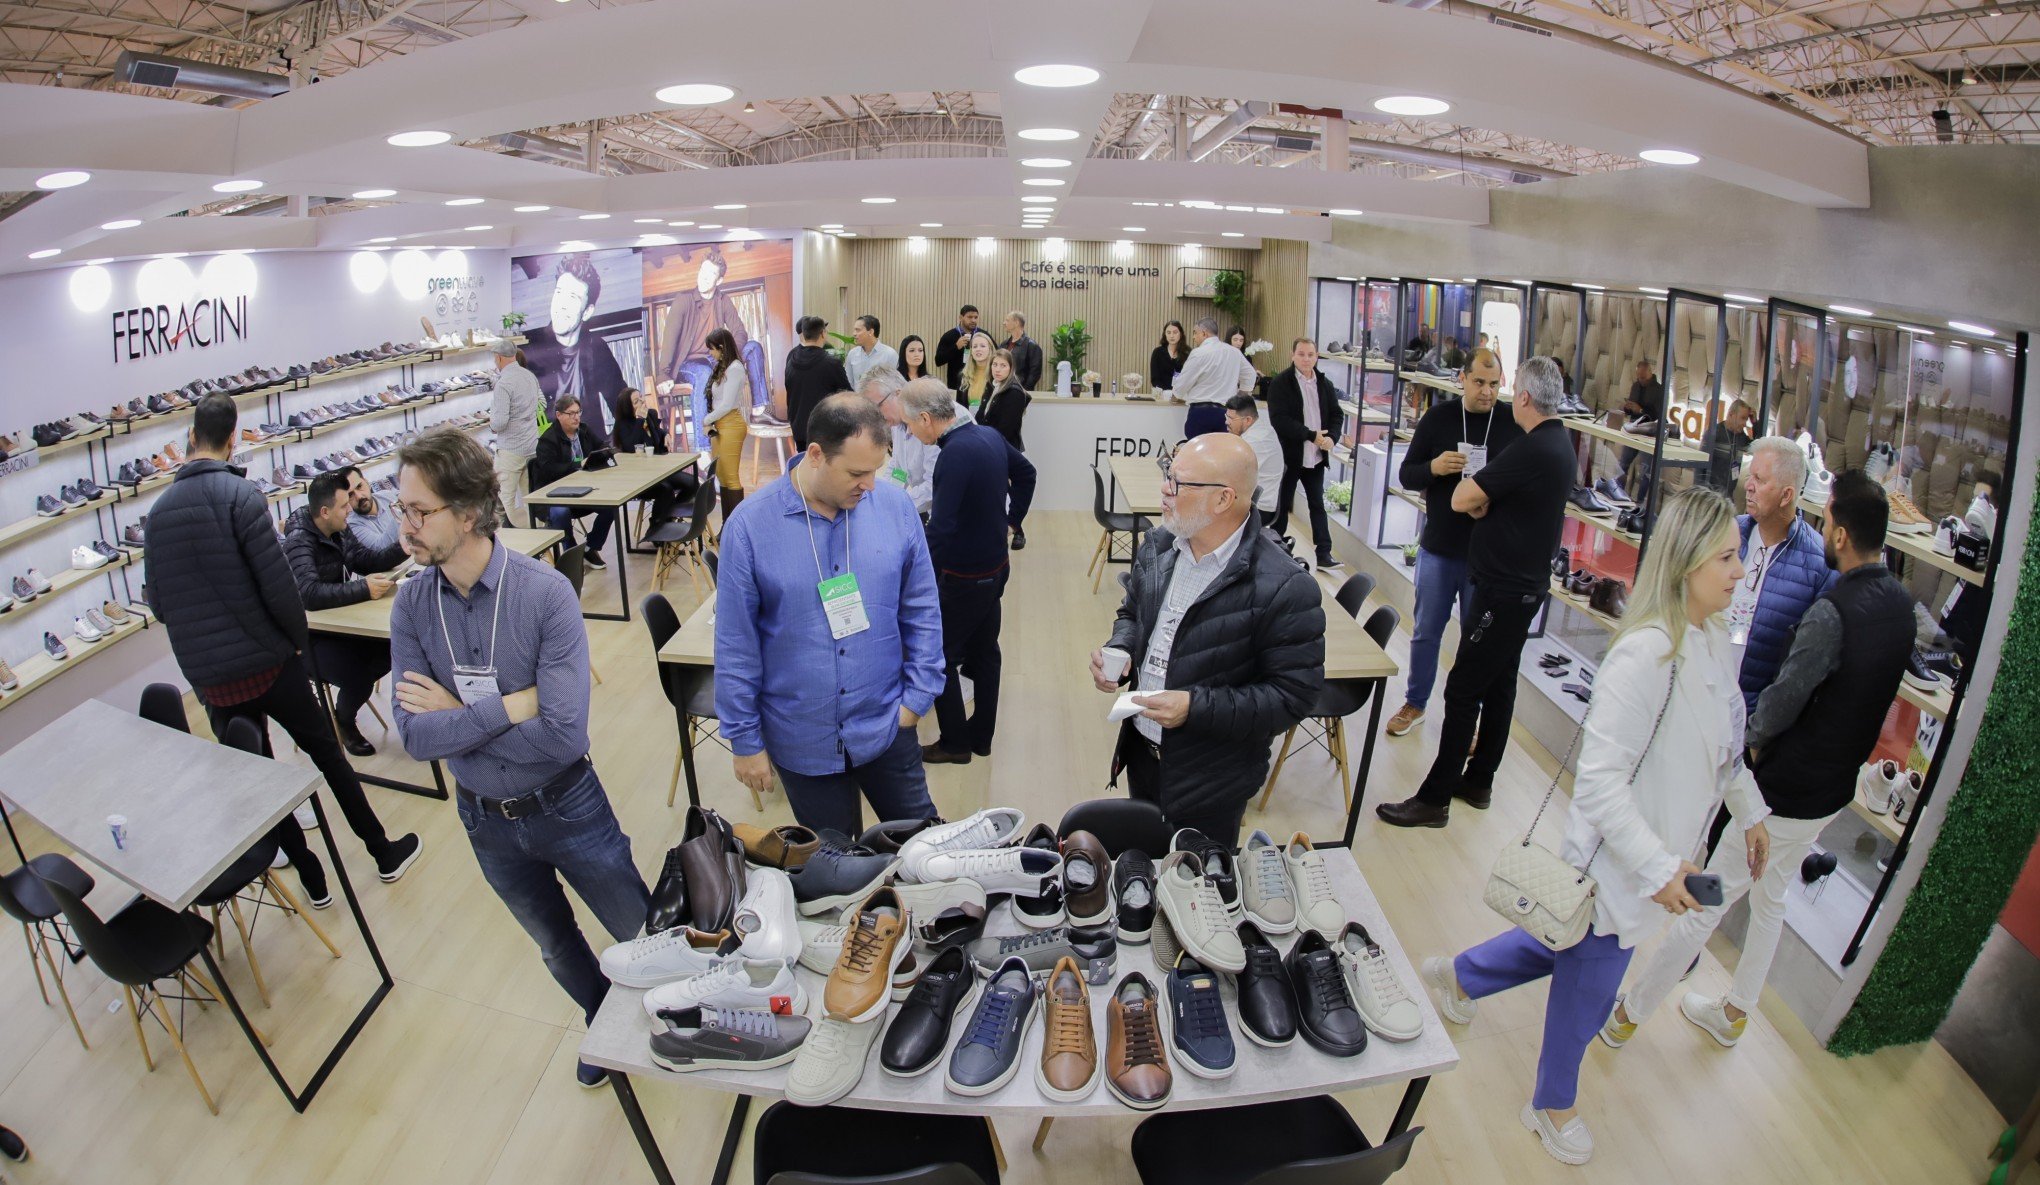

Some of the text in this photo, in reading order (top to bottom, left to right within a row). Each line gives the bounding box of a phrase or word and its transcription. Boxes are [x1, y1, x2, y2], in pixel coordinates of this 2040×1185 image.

[1020, 261, 1160, 277] Café é sempre uma
[1020, 277, 1089, 290] boa ideia!
[113, 295, 247, 363] FERRACINI
